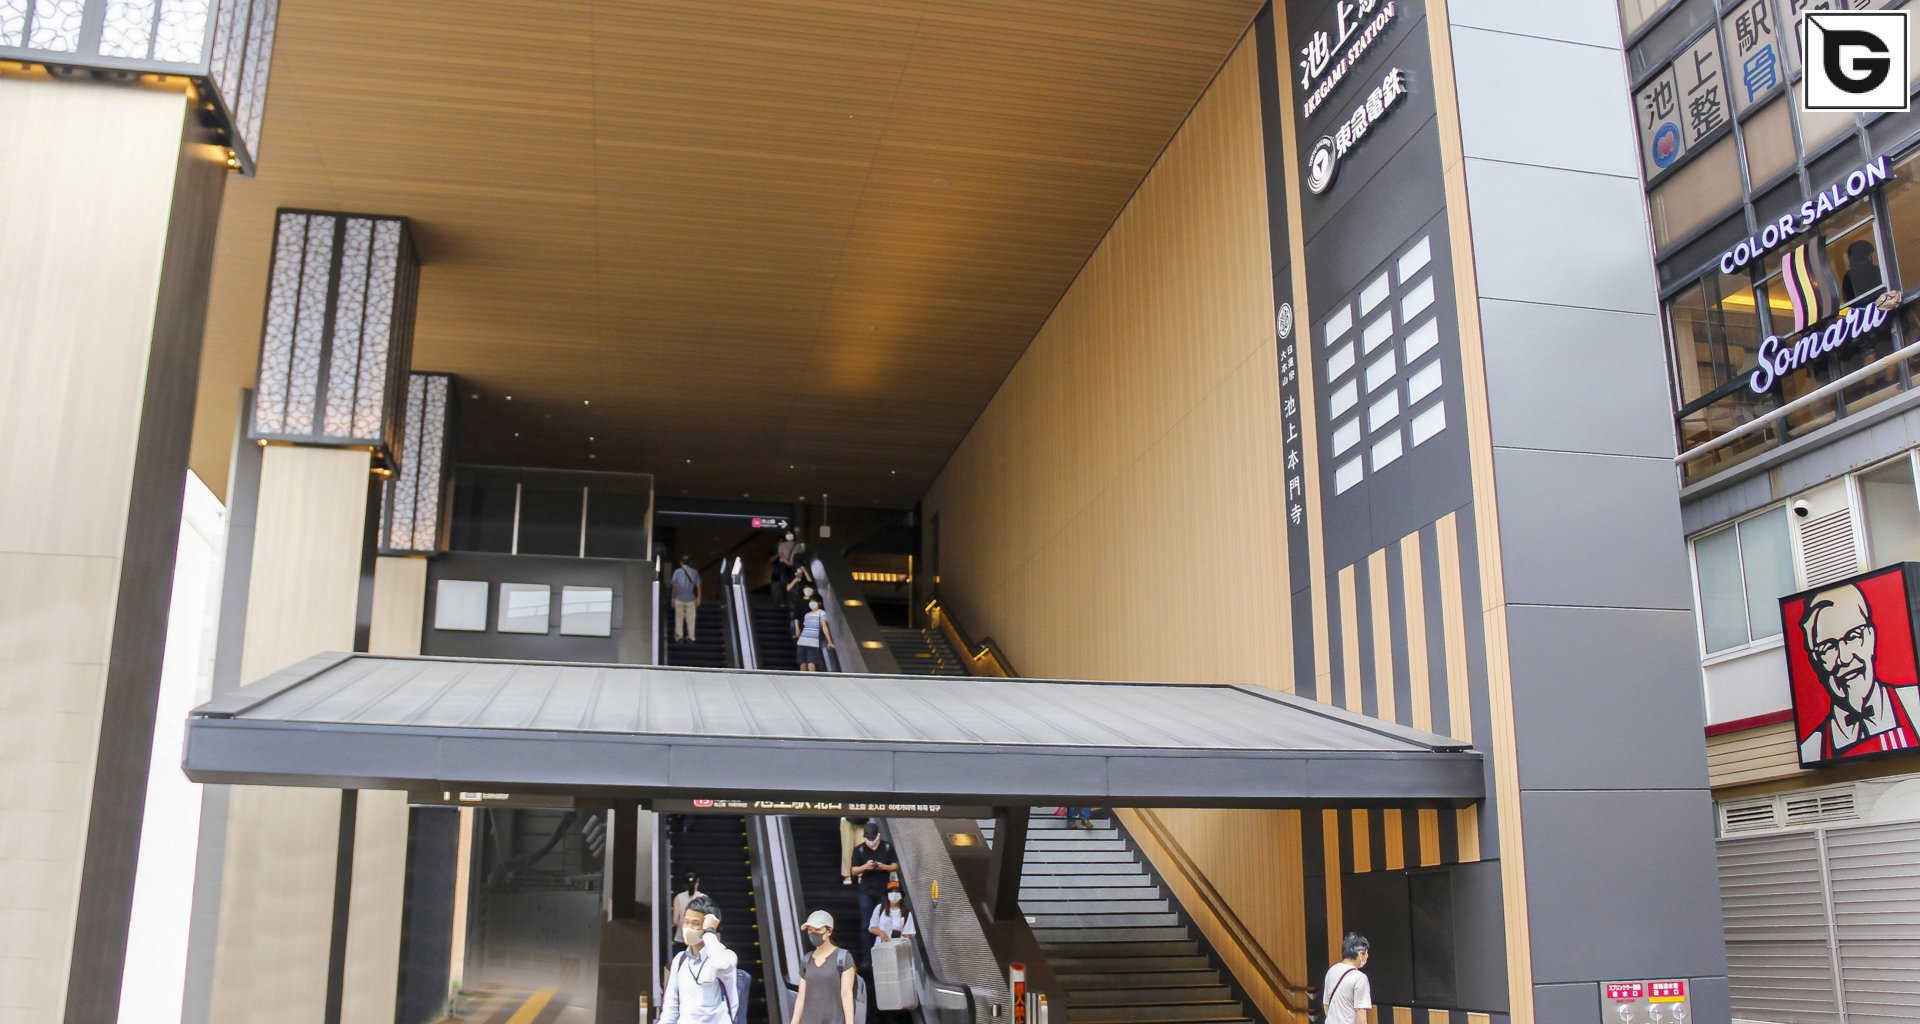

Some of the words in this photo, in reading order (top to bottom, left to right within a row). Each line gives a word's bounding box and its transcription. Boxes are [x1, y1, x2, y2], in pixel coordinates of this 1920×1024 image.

[1303, 58, 1347, 118] IKEGAMI
[1348, 1, 1396, 65] STATION
[1336, 67, 1406, 159] 東急電鉄
[1720, 213, 1796, 275] COLOR
[1800, 154, 1888, 226] SALON
[1749, 301, 1890, 394] Somaru
[1284, 395, 1303, 525] 池上本門寺
